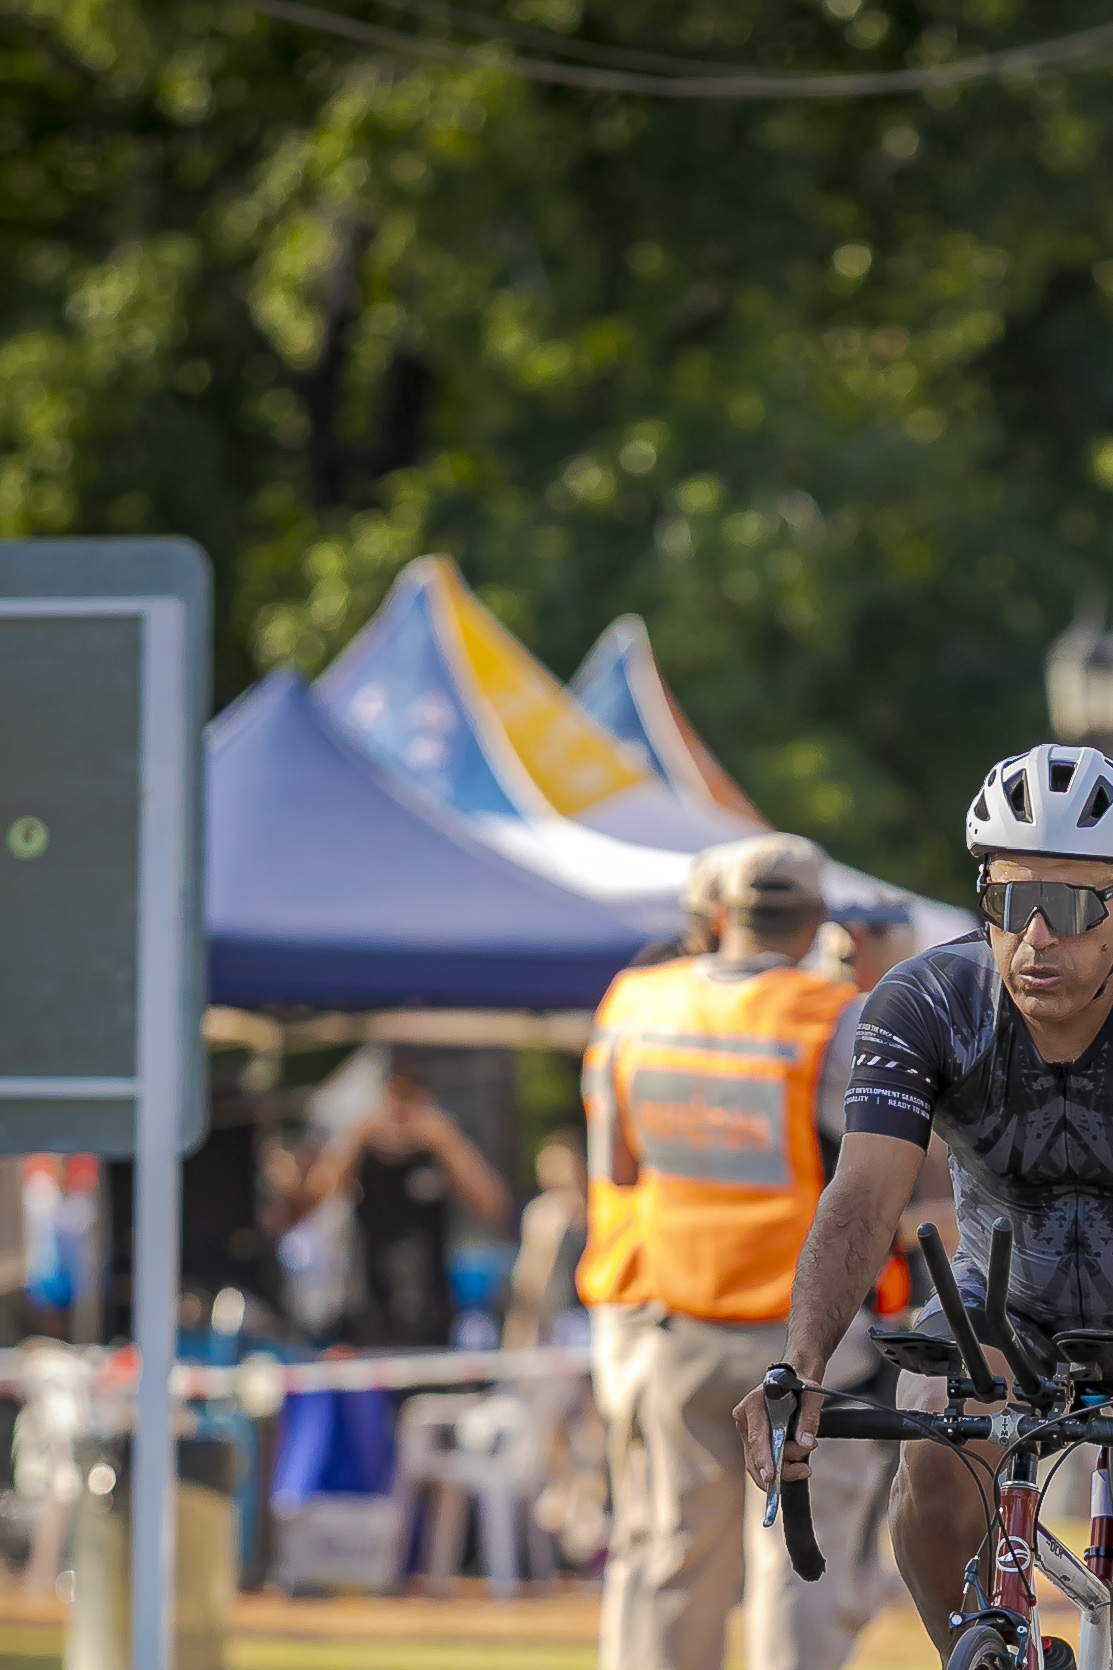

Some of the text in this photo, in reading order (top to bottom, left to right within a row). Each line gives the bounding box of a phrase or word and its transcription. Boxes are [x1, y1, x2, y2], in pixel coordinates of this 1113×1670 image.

[856, 1087, 900, 1099] DEVELOPMENT
[901, 1093, 924, 1107] SEASON
[888, 1098, 911, 1110] READY
